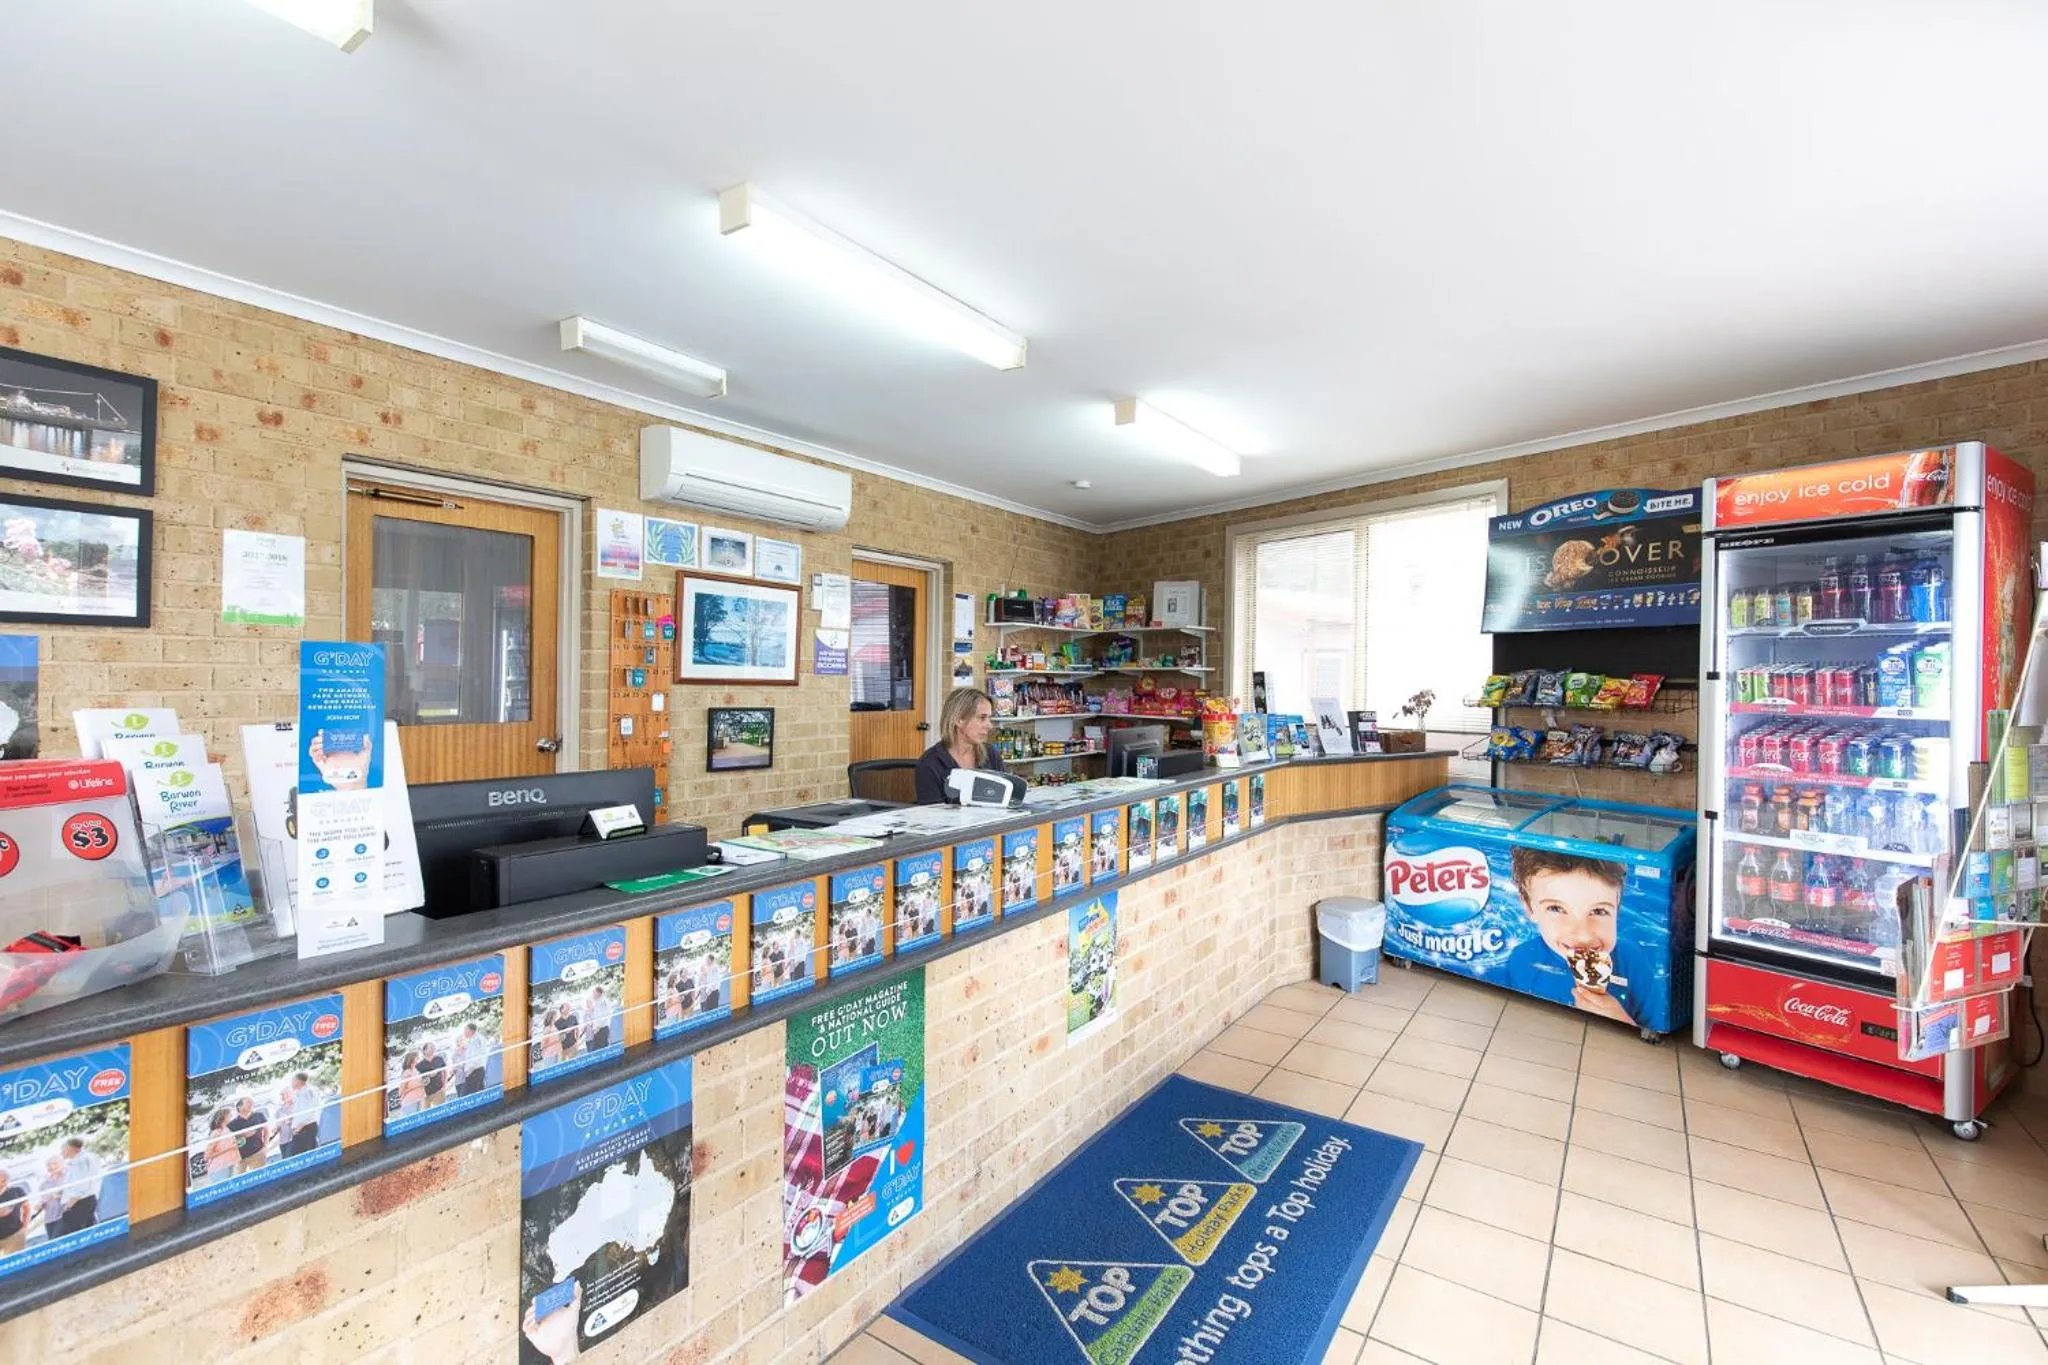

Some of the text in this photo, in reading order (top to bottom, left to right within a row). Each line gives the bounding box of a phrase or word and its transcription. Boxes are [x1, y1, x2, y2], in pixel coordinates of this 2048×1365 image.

[1650, 500, 1672, 509] BITE
[1734, 472, 1891, 506] enjoy ice cold
[1498, 520, 1523, 531] NEW
[1530, 498, 1597, 526] OREO
[313, 649, 374, 667] G'DAY
[159, 790, 202, 803] Barwon
[169, 800, 198, 814] River
[487, 787, 548, 808] BenQ
[72, 826, 110, 848] $3
[1385, 860, 1489, 895] Peters
[1398, 921, 1504, 961] Just magic
[414, 968, 481, 999] G'DAY
[811, 980, 908, 1027] FREE G'DAY MAGAZINE
[828, 1005, 874, 1031] NATIONAL
[875, 993, 902, 1010] GUIDE
[1784, 996, 1850, 1027] Coca-Cola
[226, 1010, 337, 1048] G'DAY FREE
[811, 1000, 908, 1057] OUT NOW
[2, 1065, 121, 1105] 'DAY FREE
[573, 1076, 653, 1129] G'DAY
[1218, 1121, 1264, 1156] TOP
[1153, 1183, 1209, 1229] TOP
[1186, 1184, 1251, 1254] Holiday Parks
[1173, 1135, 1353, 1365] thing tops a Top holiday.
[1067, 1266, 1137, 1326] TOP
